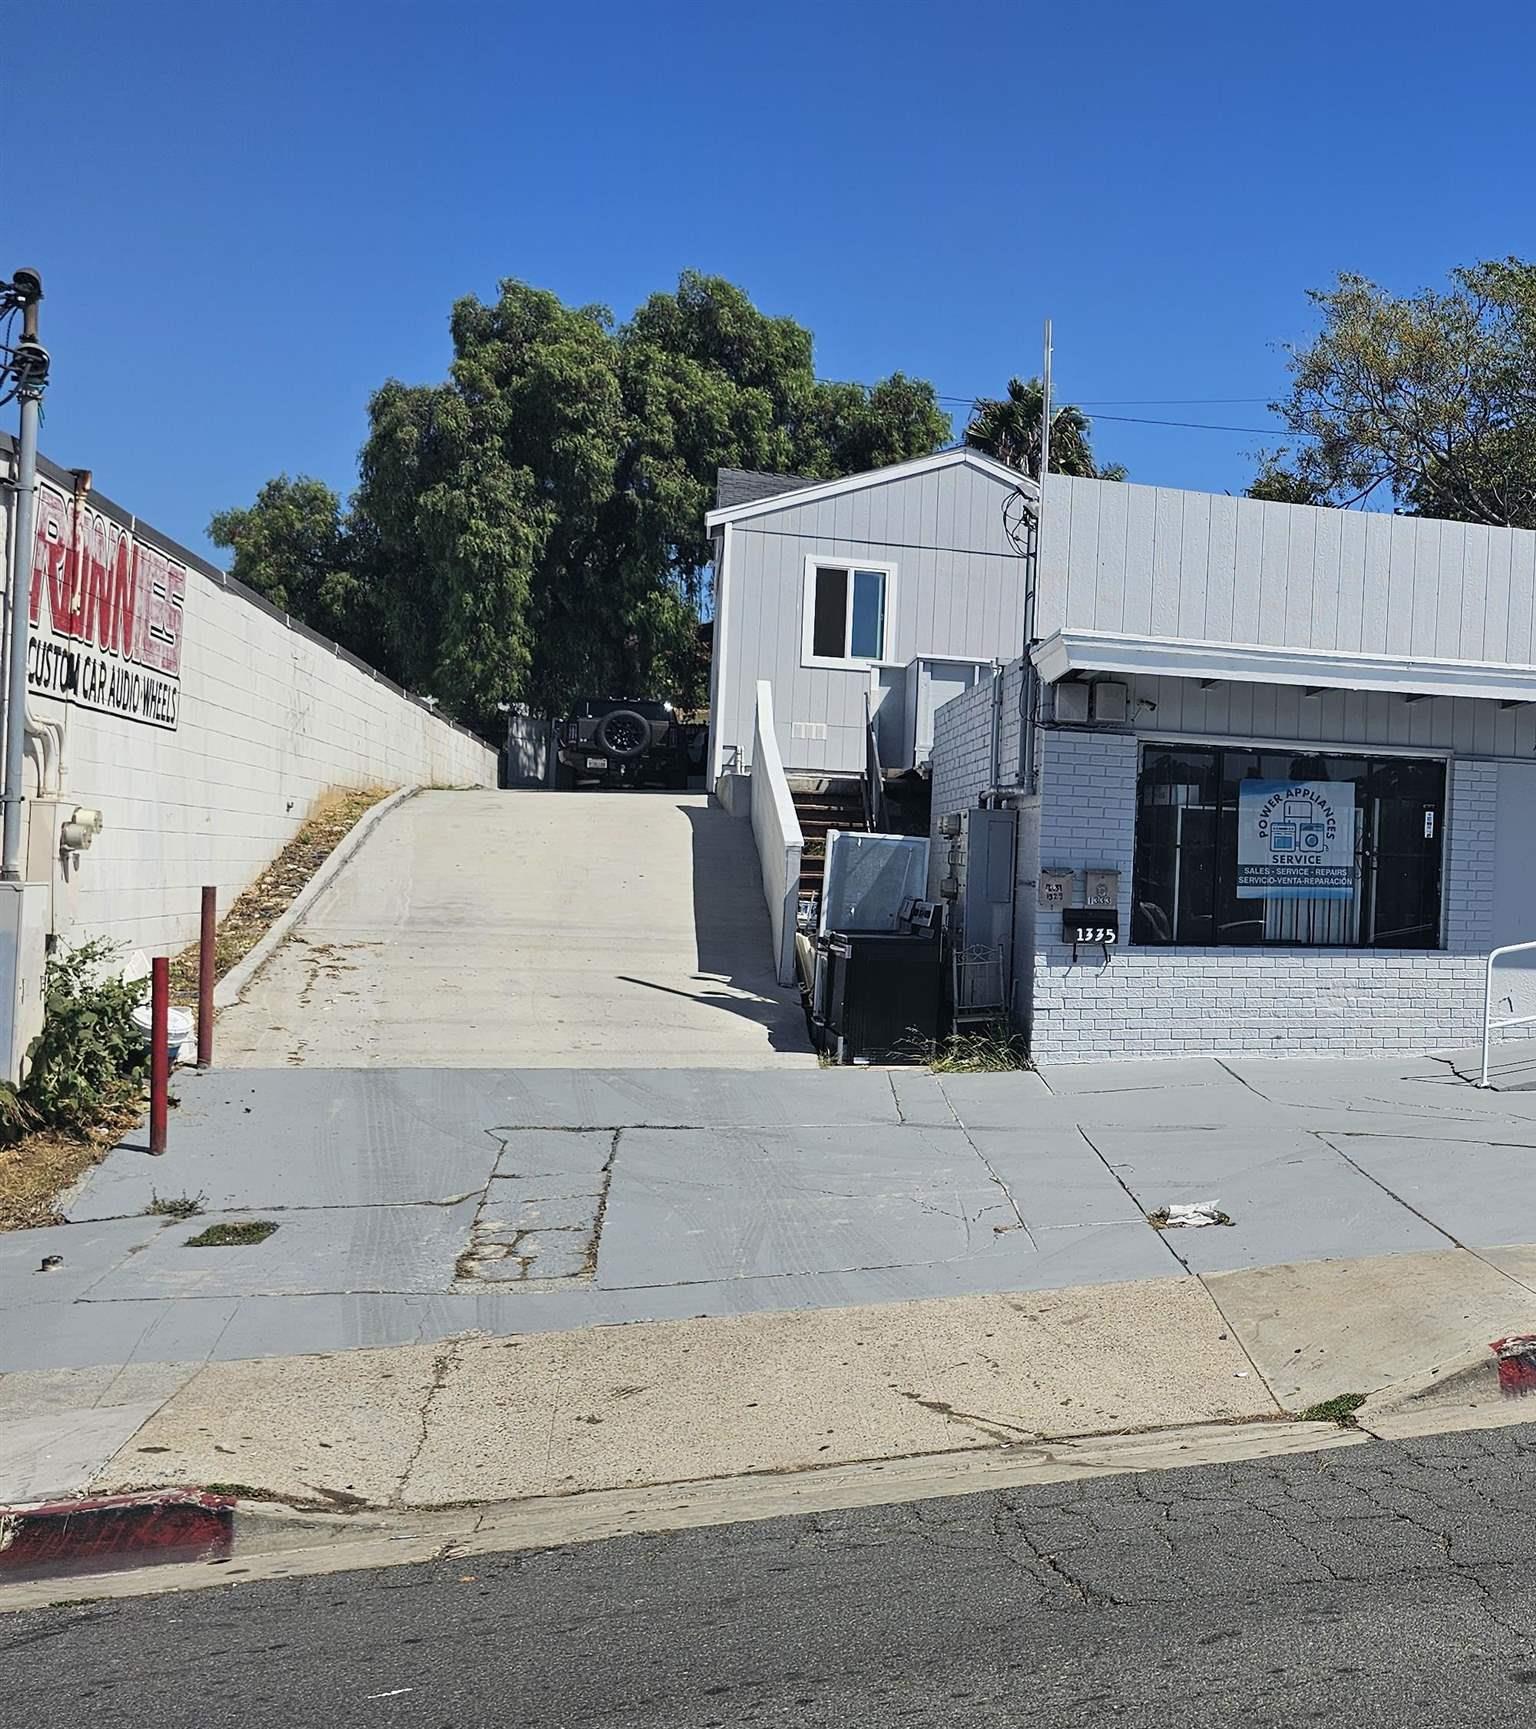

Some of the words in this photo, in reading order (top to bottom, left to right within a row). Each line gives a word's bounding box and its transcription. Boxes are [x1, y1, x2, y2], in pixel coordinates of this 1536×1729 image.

[28, 636, 80, 697] CUSTOM
[83, 655, 107, 705] CAR
[108, 665, 140, 713] AUDIO
[142, 675, 177, 724] WHEELS
[1259, 793, 1283, 838] POWER
[1286, 788, 1336, 840] APPLIANCES
[1272, 854, 1321, 865] SERVICE
[1244, 867, 1270, 875] SALES
[1276, 867, 1309, 876] SERVICE
[1315, 868, 1347, 876] REPAIRS
[1076, 927, 1116, 944] 1335
